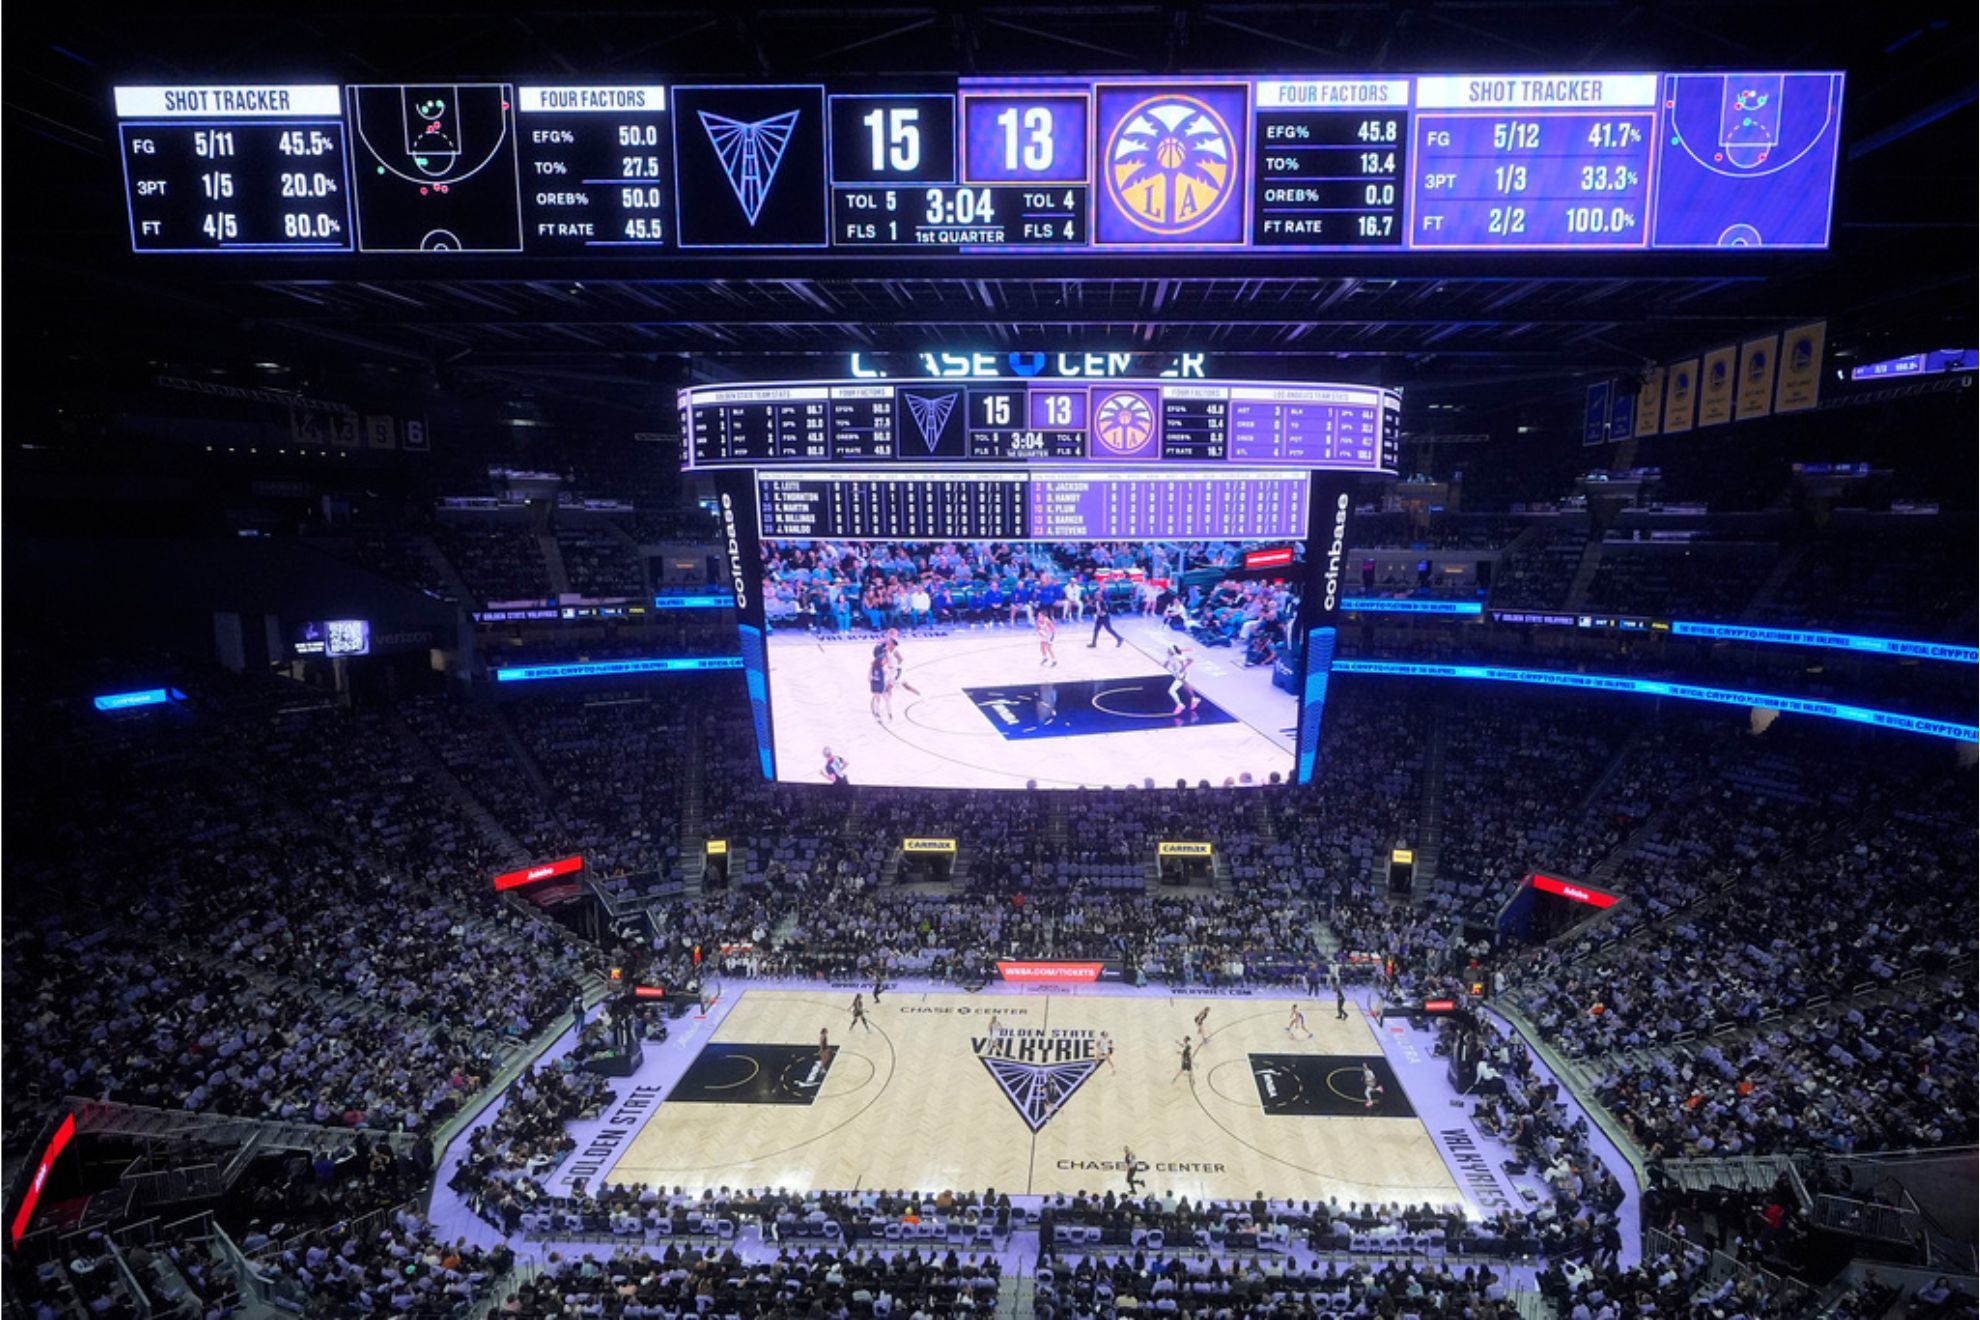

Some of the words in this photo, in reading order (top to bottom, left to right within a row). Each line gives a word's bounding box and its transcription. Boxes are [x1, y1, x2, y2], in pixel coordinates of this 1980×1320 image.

[165, 90, 206, 111] SHOT
[207, 90, 290, 110] TRACKER
[540, 90, 578, 108] FOUR
[582, 90, 645, 108] FACTORS
[1278, 85, 1318, 103] FOUR
[1321, 85, 1388, 102] FACTORS
[1469, 81, 1515, 102] SHOT
[1519, 80, 1602, 101] TRACKER
[533, 131, 574, 144] EFG%
[619, 126, 656, 146] 50.0
[864, 108, 919, 171] 15
[998, 108, 1053, 170] 13
[1267, 126, 1309, 139] EFG%
[1358, 122, 1396, 141] 45.8
[1428, 131, 1450, 146] FG
[1494, 124, 1539, 148] 5/12
[1588, 123, 1641, 148] 41.7%
[133, 138, 155, 155] FG
[194, 132, 234, 157] 5/11
[279, 131, 333, 156] 45.5%
[534, 161, 567, 174] TO%
[622, 157, 658, 178] 27.5
[1266, 157, 1299, 170] TO%
[1360, 153, 1395, 173] 13.4
[137, 180, 166, 196] 3PT
[201, 173, 233, 197] 1/5
[281, 173, 337, 197] 20.0%
[1425, 174, 1456, 188] 3PT
[1495, 168, 1526, 191] 1/3
[1581, 166, 1638, 190] 33.3%
[536, 192, 588, 206] OREB%
[622, 188, 659, 208] 50.0
[846, 195, 876, 209] TOL
[885, 190, 896, 210] 5
[1024, 193, 1054, 207] TOL
[1063, 190, 1074, 208] 4
[1144, 186, 1160, 216] L
[1179, 183, 1198, 216] A
[1265, 189, 1319, 202] OREB%
[1365, 184, 1393, 205] 0.0
[926, 188, 994, 224] 3:04
[142, 221, 161, 236] FT
[203, 214, 237, 239] 4/5
[285, 214, 340, 237] 80.0%
[538, 223, 556, 236] FT
[559, 223, 594, 236] RATE
[625, 219, 661, 238] 45.5
[847, 225, 875, 238] FLS
[889, 221, 897, 240] 1
[1024, 223, 1053, 238] FLS
[1063, 220, 1074, 239] 4
[1264, 220, 1282, 233] FT
[1285, 220, 1322, 233] RATE
[1358, 216, 1392, 236] 16.7
[1423, 216, 1443, 230] FT
[1488, 209, 1525, 233] 2/2
[1566, 209, 1634, 232] 100.0%
[915, 232, 935, 243] 1st
[939, 232, 1004, 243] QUARTER
[983, 396, 1010, 424] 15
[1045, 396, 1072, 424] 13
[407, 421, 423, 443] 6
[1011, 432, 1044, 449] 3:04
[722, 493, 747, 609] coinbase
[1324, 493, 1348, 611] coinbase
[1716, 628, 1758, 638] CRYPTO
[1930, 646, 1978, 660] CRYPTO
[1706, 689, 1744, 703] CRYPTO
[1915, 720, 1963, 737] CRYPTO
[900, 1006, 953, 1014] CHASE
[974, 1007, 1028, 1015] CENTER
[1000, 1028, 1045, 1037] OLDEN
[1052, 1028, 1095, 1038] STATE
[971, 1036, 1096, 1063] VALKYRIE
[610, 1084, 662, 1126] STATE
[1155, 1162, 1226, 1174] CENTER
